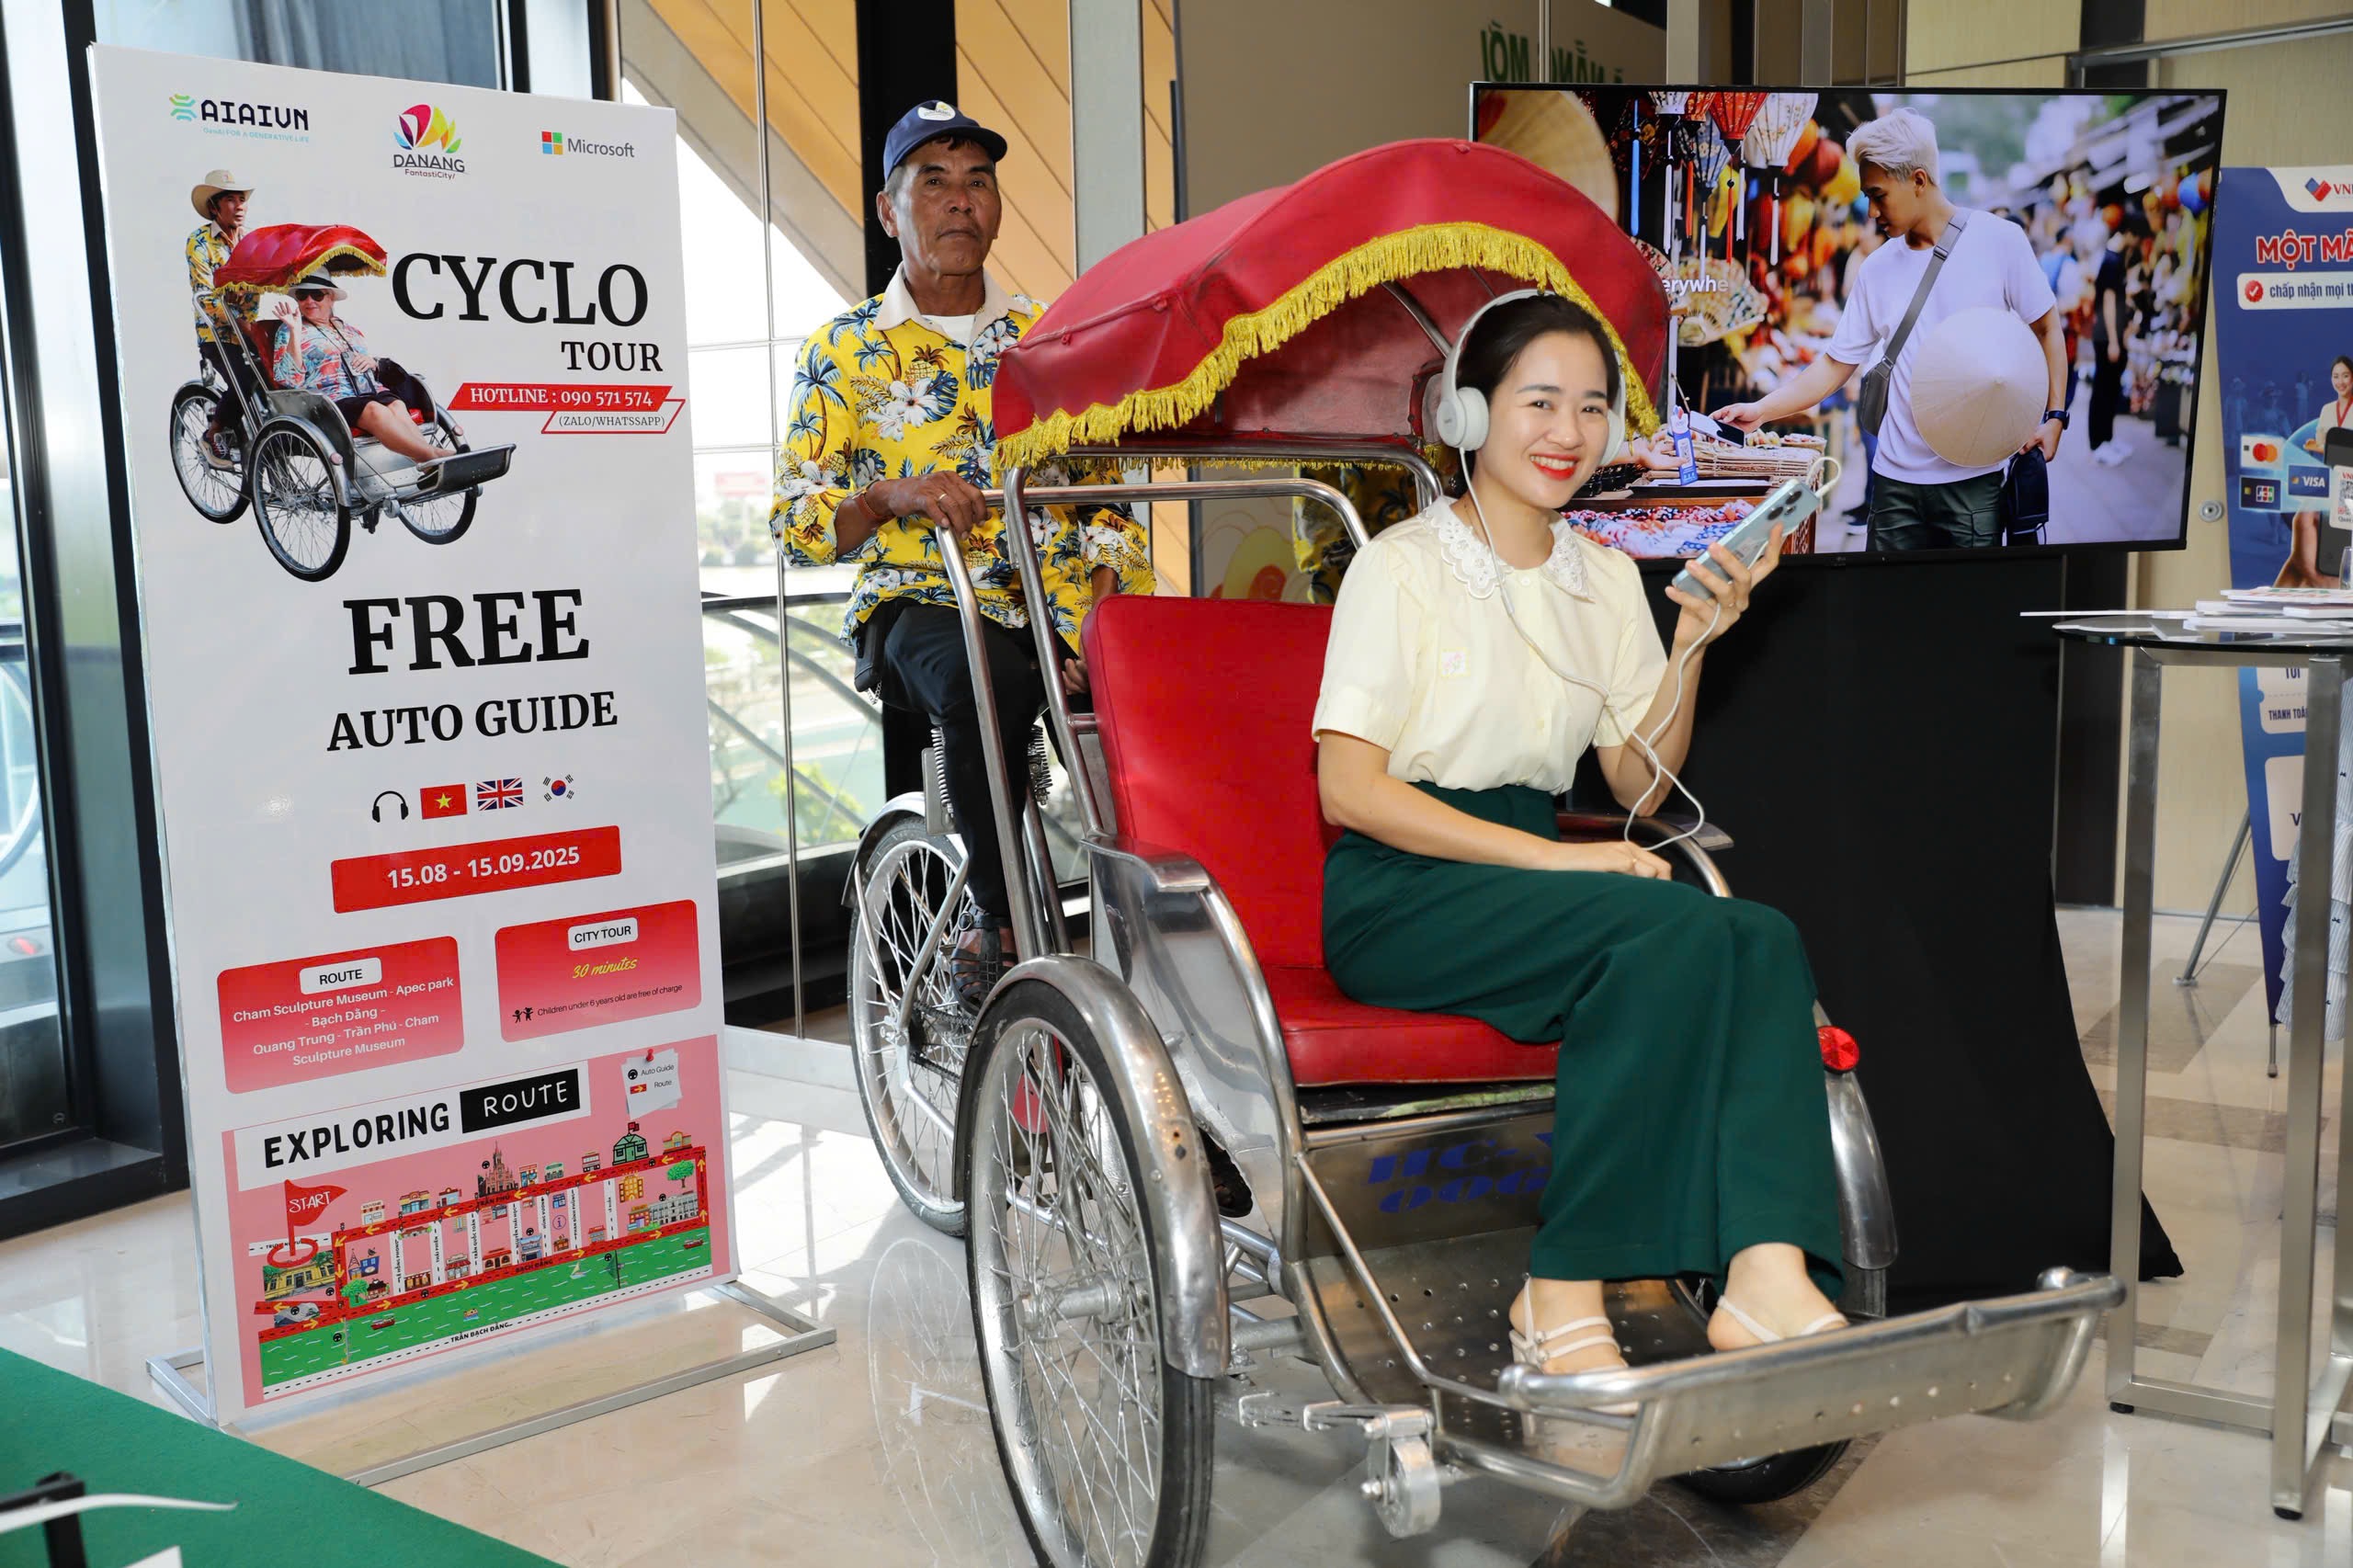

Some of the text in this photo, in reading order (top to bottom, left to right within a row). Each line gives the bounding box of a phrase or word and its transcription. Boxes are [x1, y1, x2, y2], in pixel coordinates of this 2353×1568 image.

[200, 99, 309, 131] AIAIVN
[567, 138, 634, 158] Microsoft
[393, 153, 465, 173] DANANG
[2256, 229, 2316, 271] MỘT
[392, 253, 648, 326] CYCLO
[2269, 281, 2295, 300] chấp
[2298, 281, 2322, 300] nhận
[2325, 281, 2344, 300] mọi
[561, 341, 663, 372] TOUR
[470, 388, 547, 403] HOTLINE
[561, 391, 591, 405] 090
[596, 392, 621, 406] 571
[625, 392, 654, 407] 574
[559, 415, 665, 427] (ZALO/WHATSSAPP)
[2302, 476, 2325, 487] VISA
[343, 588, 589, 675] FREE
[327, 691, 618, 751] AUTO GUIDE
[2268, 707, 2308, 721] THANH TOÁ
[387, 863, 448, 889] 15.08
[467, 846, 581, 878] 15.09.2025
[574, 926, 631, 943] CITY TOUR
[319, 969, 363, 985] ROUTE
[572, 957, 638, 979] 30 minutes
[233, 1008, 271, 1023] Cham
[273, 996, 334, 1018] Sculpture
[336, 989, 388, 1006] Museum
[396, 983, 426, 997] Apec
[427, 977, 454, 993] park
[538, 1005, 568, 1017] Children
[568, 1001, 589, 1011] under
[589, 999, 595, 1007] 6
[595, 996, 614, 1007] years
[638, 990, 651, 998] free
[659, 983, 683, 995] charge
[312, 1014, 343, 1030] Bạch
[253, 1040, 296, 1055] Quang
[299, 1032, 335, 1048] Trung
[344, 1026, 371, 1039] Trần
[374, 1020, 397, 1034] Phú
[404, 1014, 439, 1028] Cham
[292, 1038, 405, 1066] Sculpture Museum
[641, 1063, 675, 1076] Auto Guide
[654, 1079, 672, 1088] Route
[264, 1080, 568, 1168] EXPLORING ROUTE
[289, 1191, 330, 1213] START
